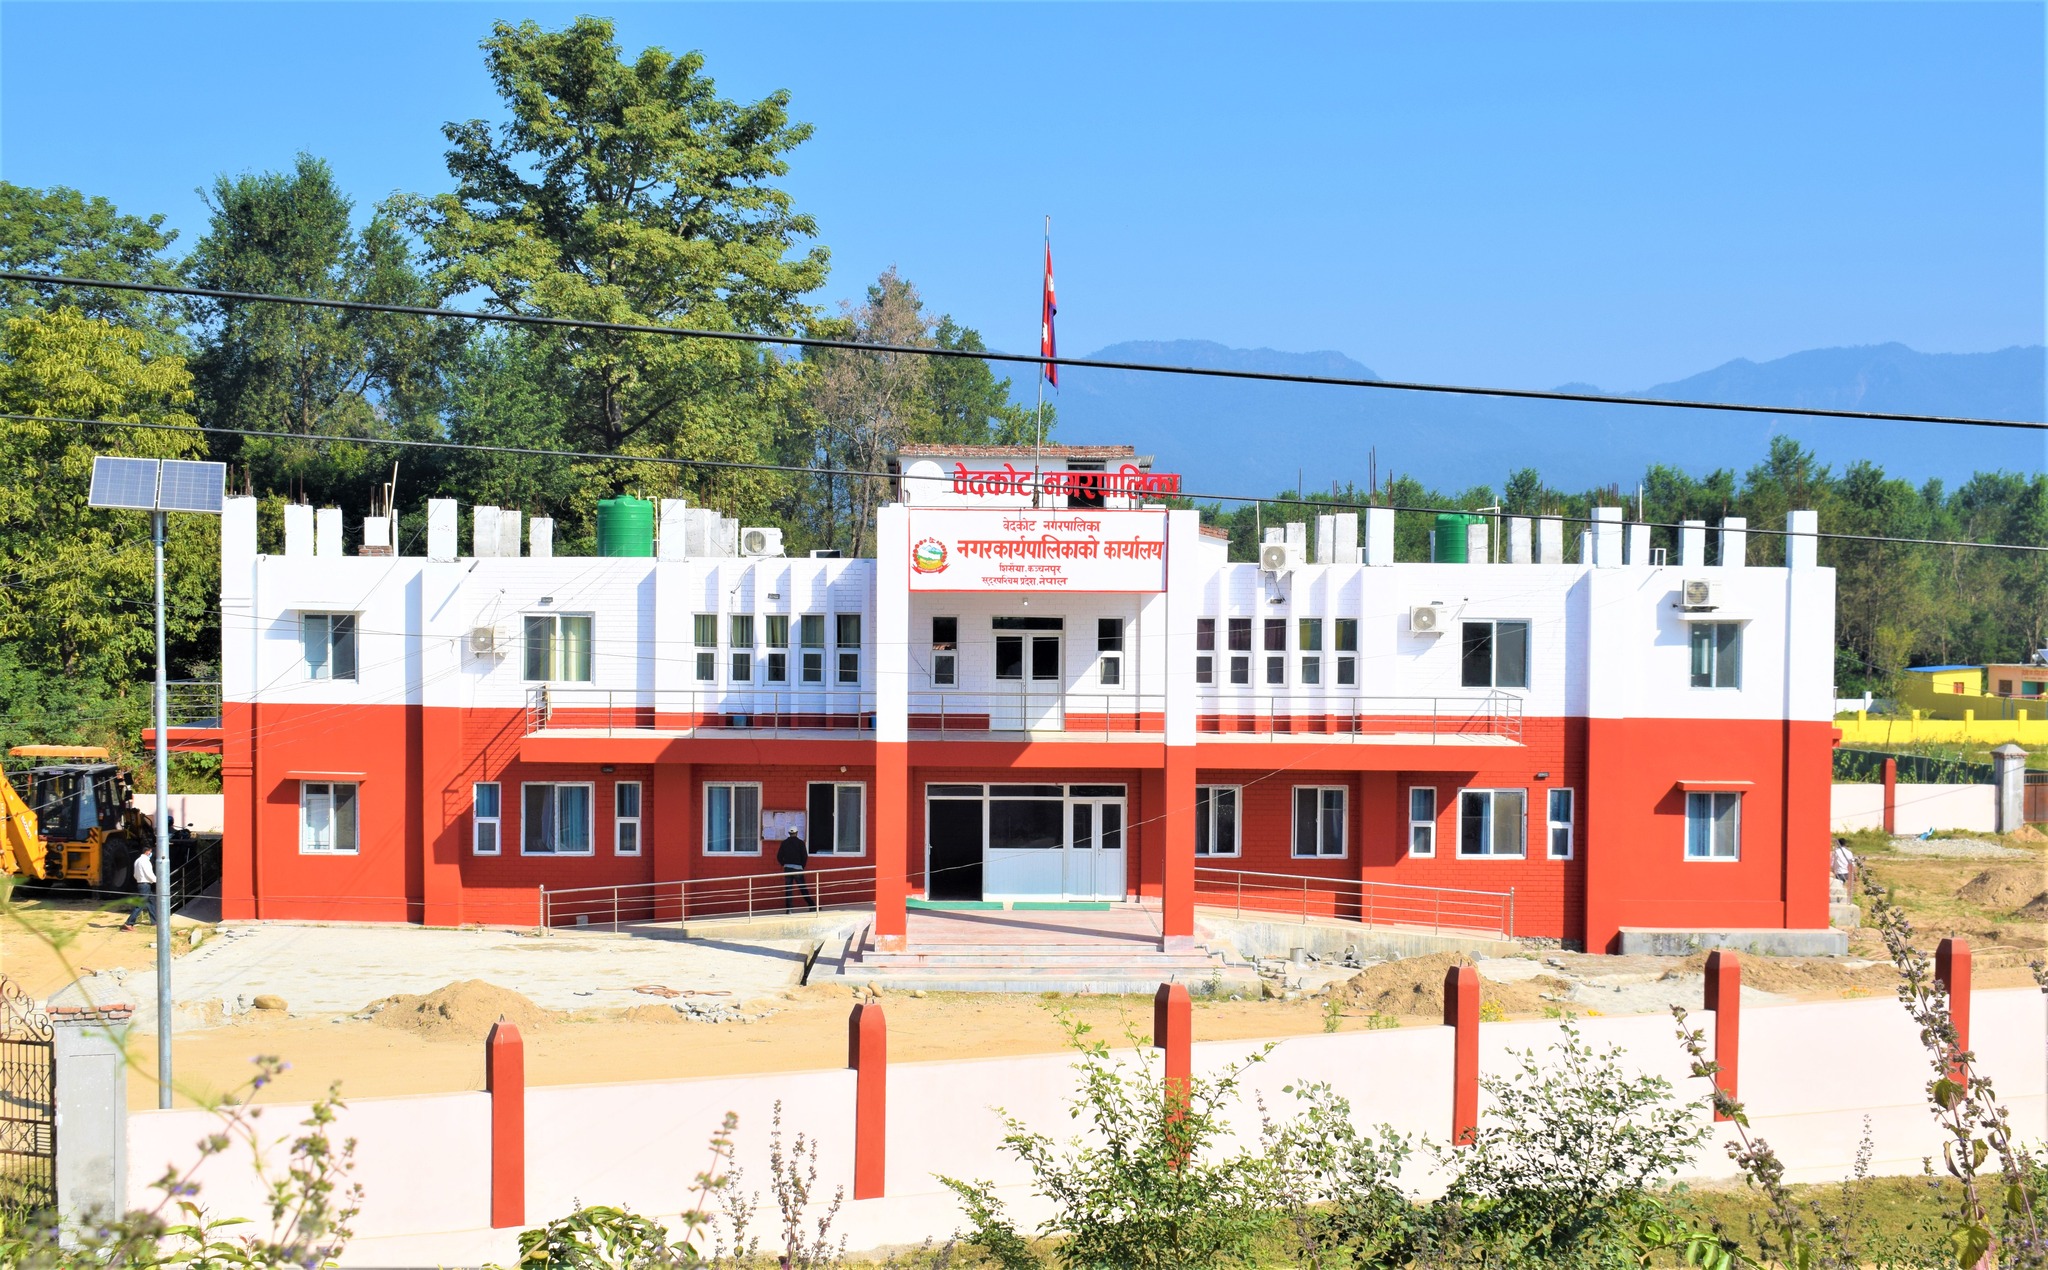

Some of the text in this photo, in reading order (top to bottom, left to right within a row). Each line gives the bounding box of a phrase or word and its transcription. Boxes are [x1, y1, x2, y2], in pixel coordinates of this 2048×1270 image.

[953, 462, 1181, 500] वेदकोट नगरपालिका
[1003, 516, 1101, 532] वेदकोट नगरपालिका
[957, 534, 1165, 560] नगरकार्यपालिकाको कार्यालय
